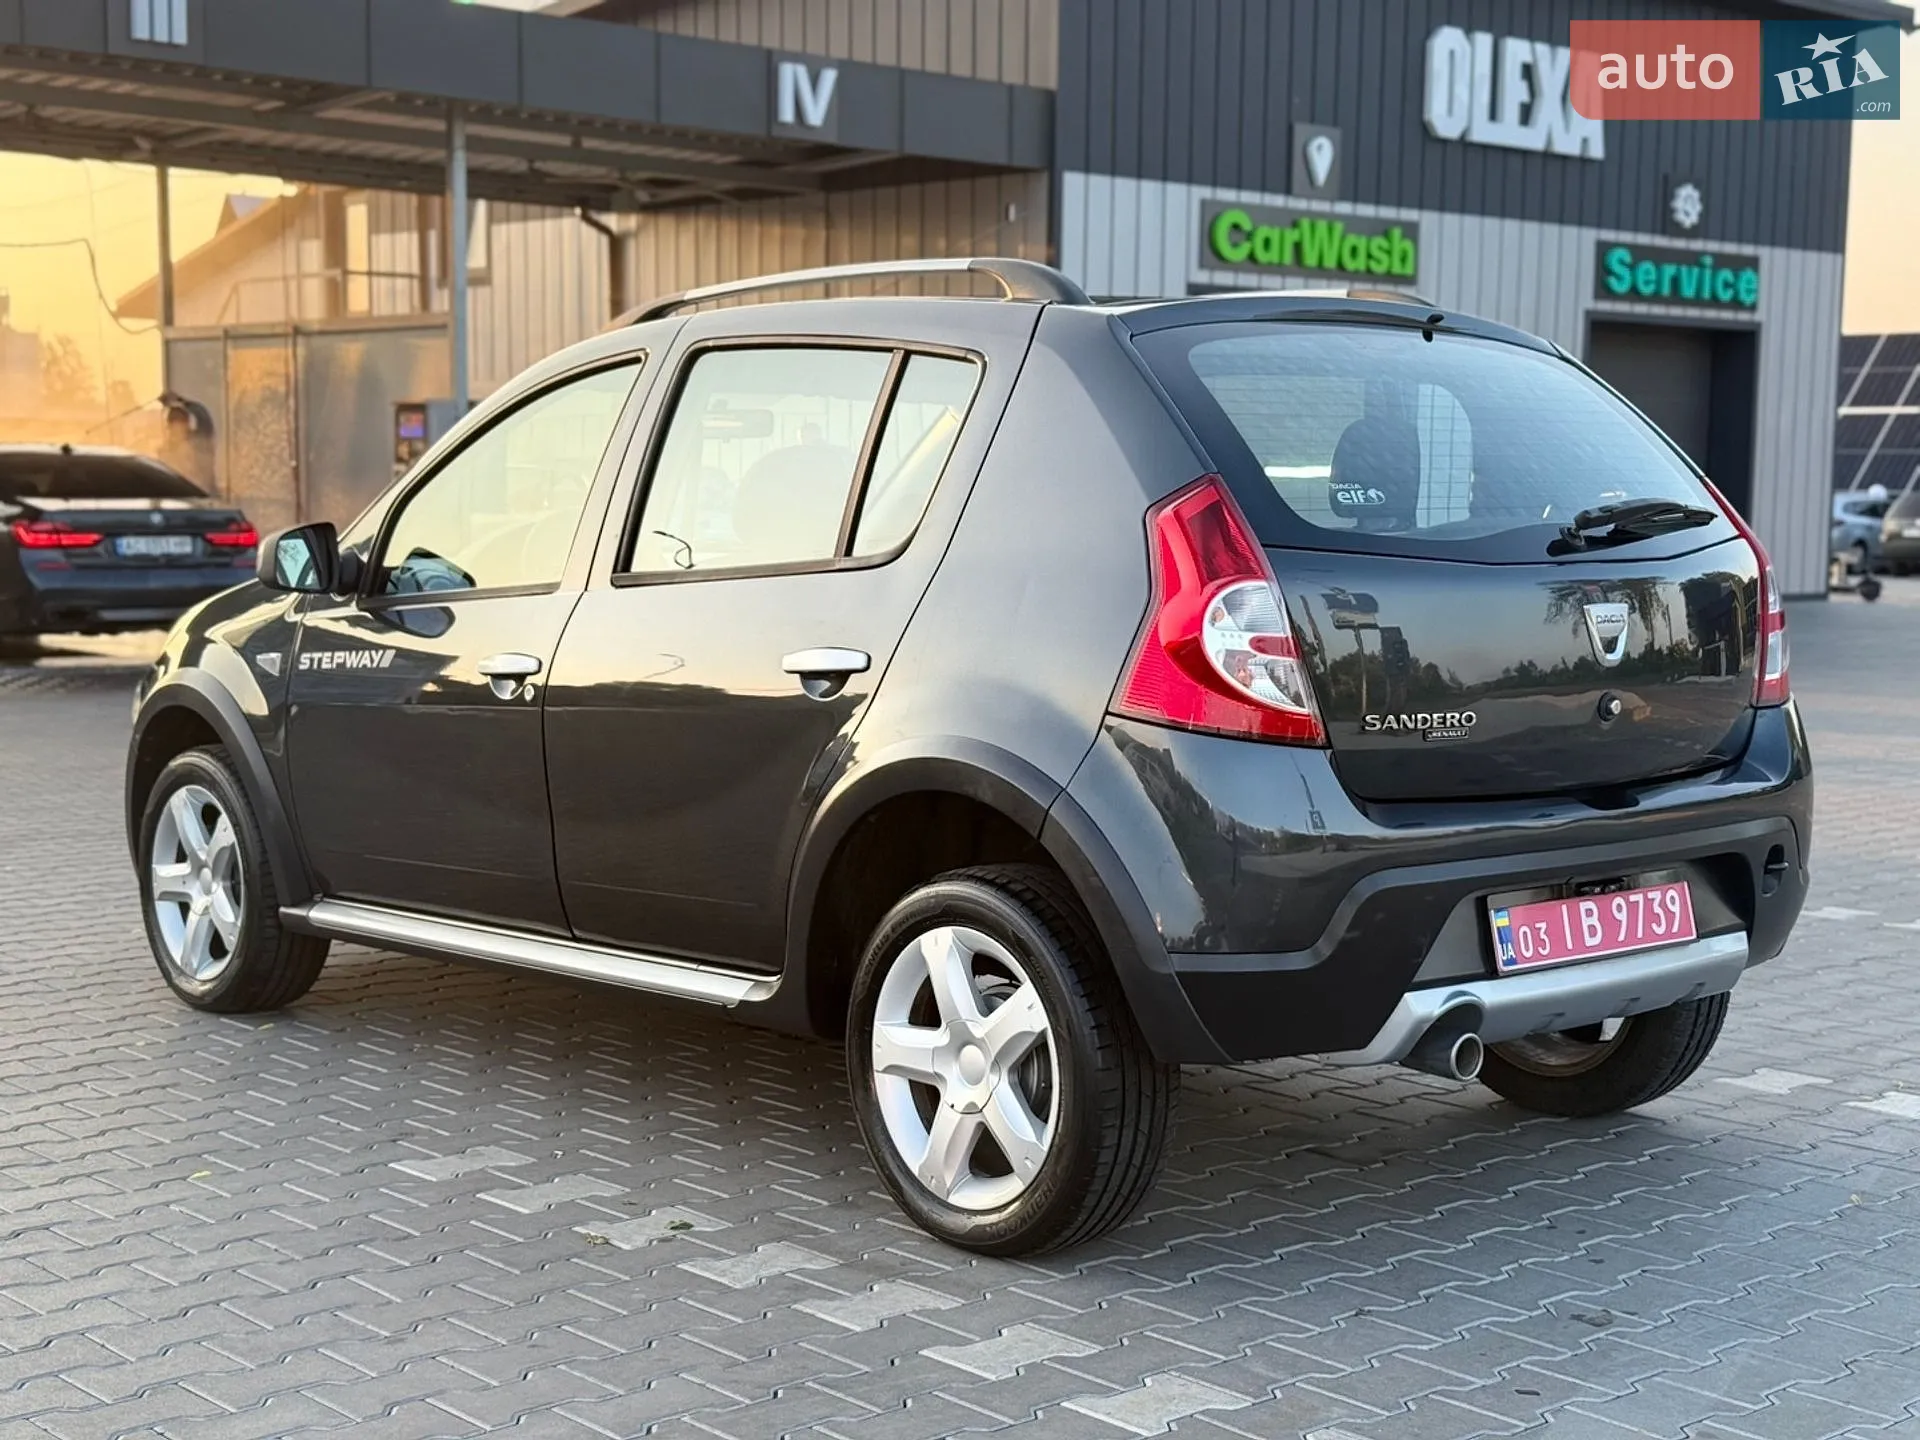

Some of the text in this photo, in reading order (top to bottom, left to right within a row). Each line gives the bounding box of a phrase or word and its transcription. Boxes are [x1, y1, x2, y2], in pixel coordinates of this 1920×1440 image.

[778, 62, 839, 128] IV
[1423, 25, 1605, 161] OLEXA
[1210, 208, 1415, 277] CarWash
[1604, 246, 1759, 307] Service
[1596, 614, 1626, 624] DACIA
[298, 650, 384, 670] STEPWAY
[1364, 711, 1477, 731] SANDERO
[1499, 942, 1516, 960] UA
[1518, 888, 1680, 958] 03 IB 9739
